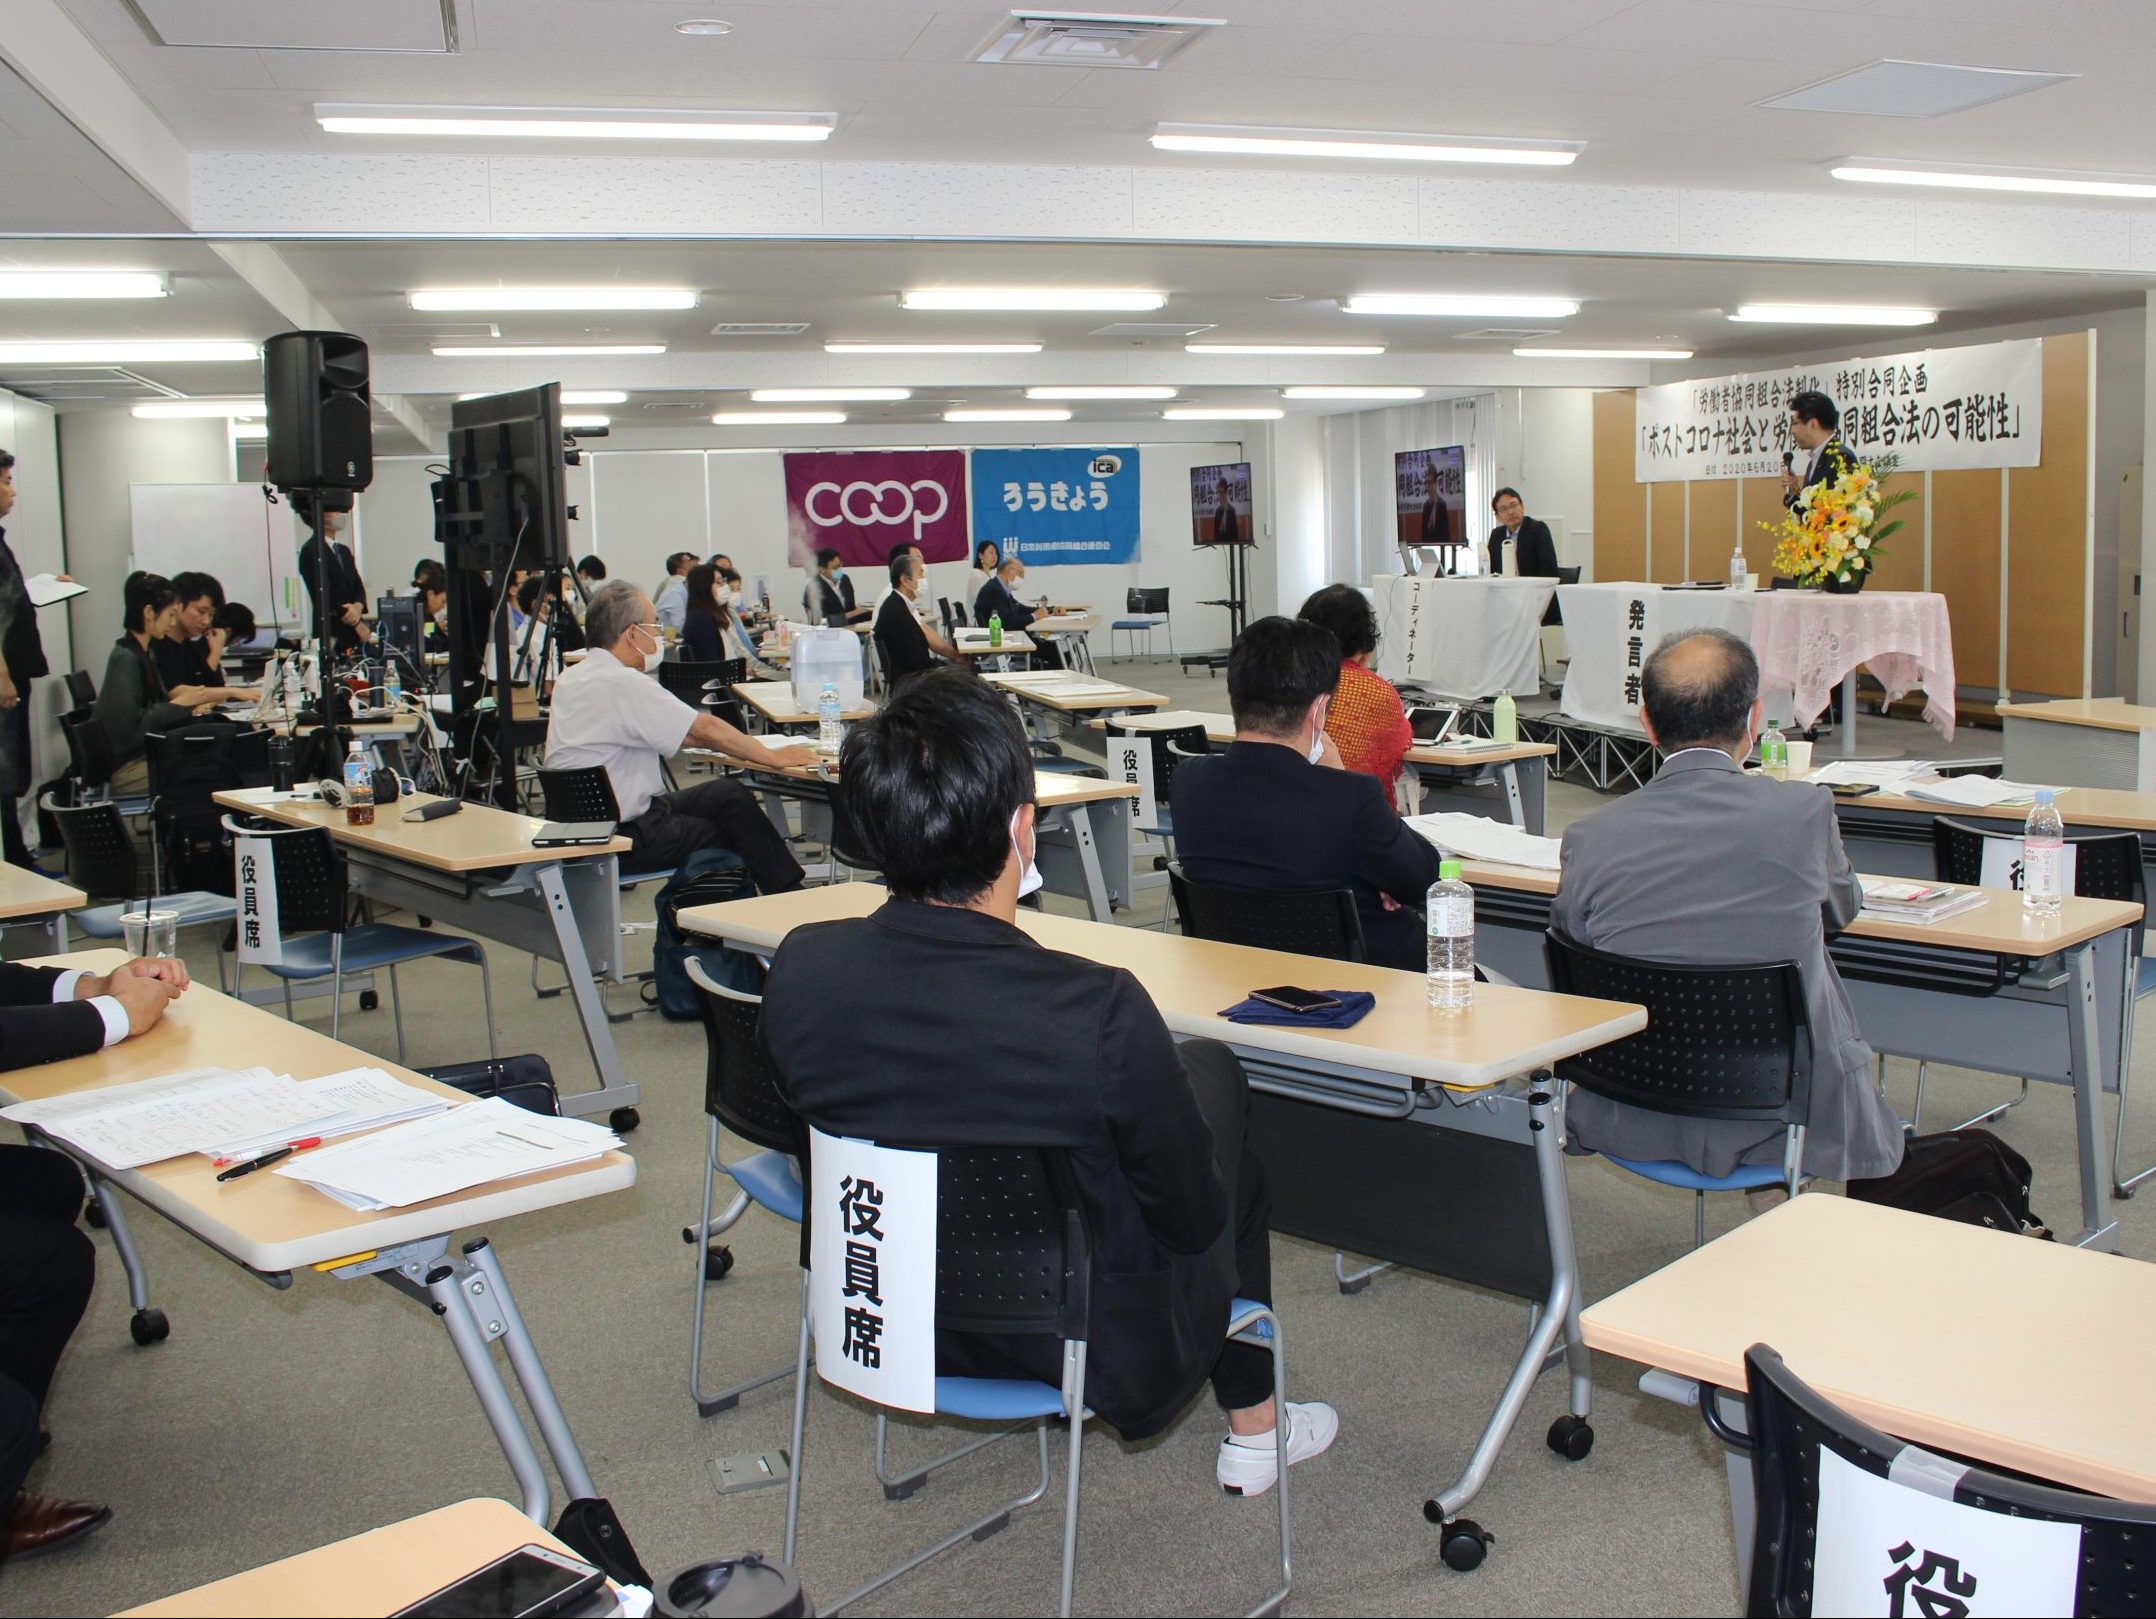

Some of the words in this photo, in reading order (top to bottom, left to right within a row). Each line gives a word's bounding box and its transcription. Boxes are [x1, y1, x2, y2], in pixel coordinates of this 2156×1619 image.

[1836, 362, 1929, 401] 特別合同企画
[1641, 391, 2020, 460] 「ポストコロナ社会と労同組合法の可能性」
[1003, 481, 1109, 512] ろうきょう
[1092, 458, 1115, 474] ica
[1624, 599, 1645, 705] 発言者
[241, 855, 261, 949] 役員席
[839, 1175, 885, 1369] 役員席
